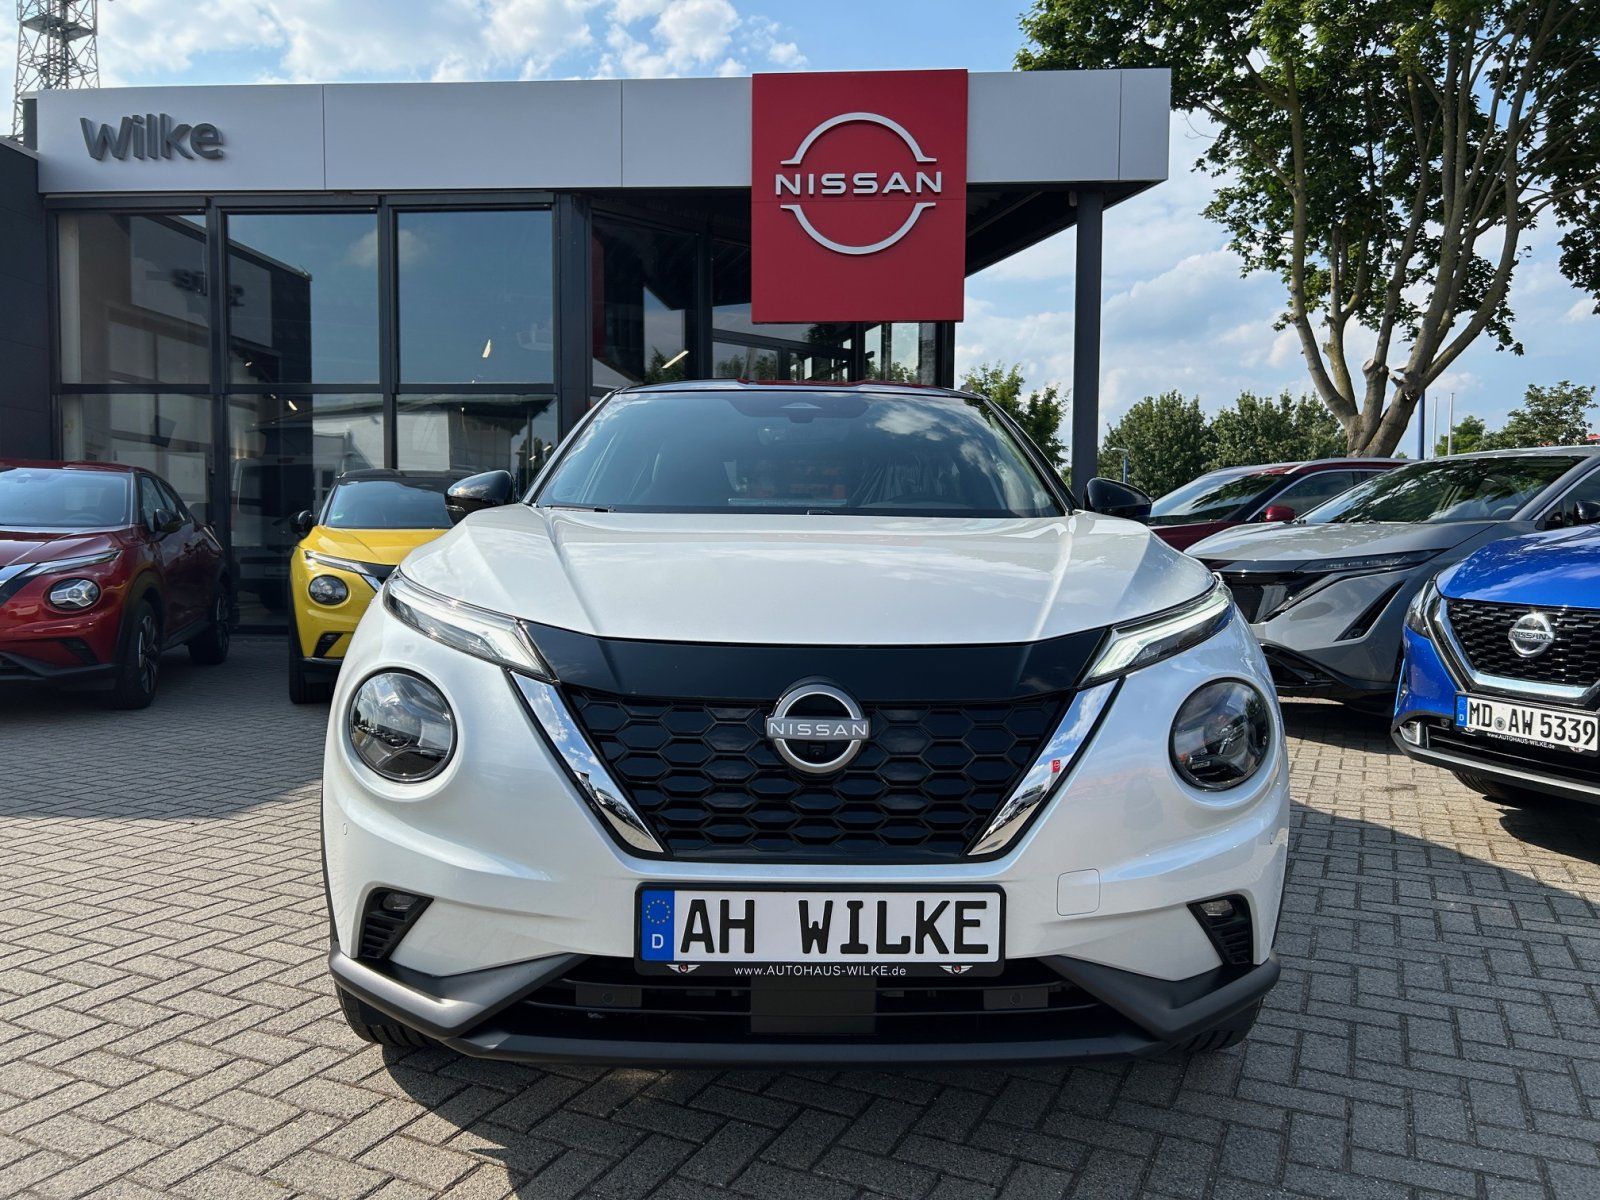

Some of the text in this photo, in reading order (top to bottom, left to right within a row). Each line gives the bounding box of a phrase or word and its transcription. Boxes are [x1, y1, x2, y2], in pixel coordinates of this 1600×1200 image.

[80, 113, 224, 161] Wilke
[775, 171, 942, 195] NISSAN
[1511, 630, 1547, 640] NISSAN
[770, 722, 866, 736] NISSAN
[1459, 701, 1596, 746] D MD AW 5339
[651, 899, 989, 954] D AH WILKE
[734, 965, 907, 976] www.AUTOHAUS-WILKE.de
